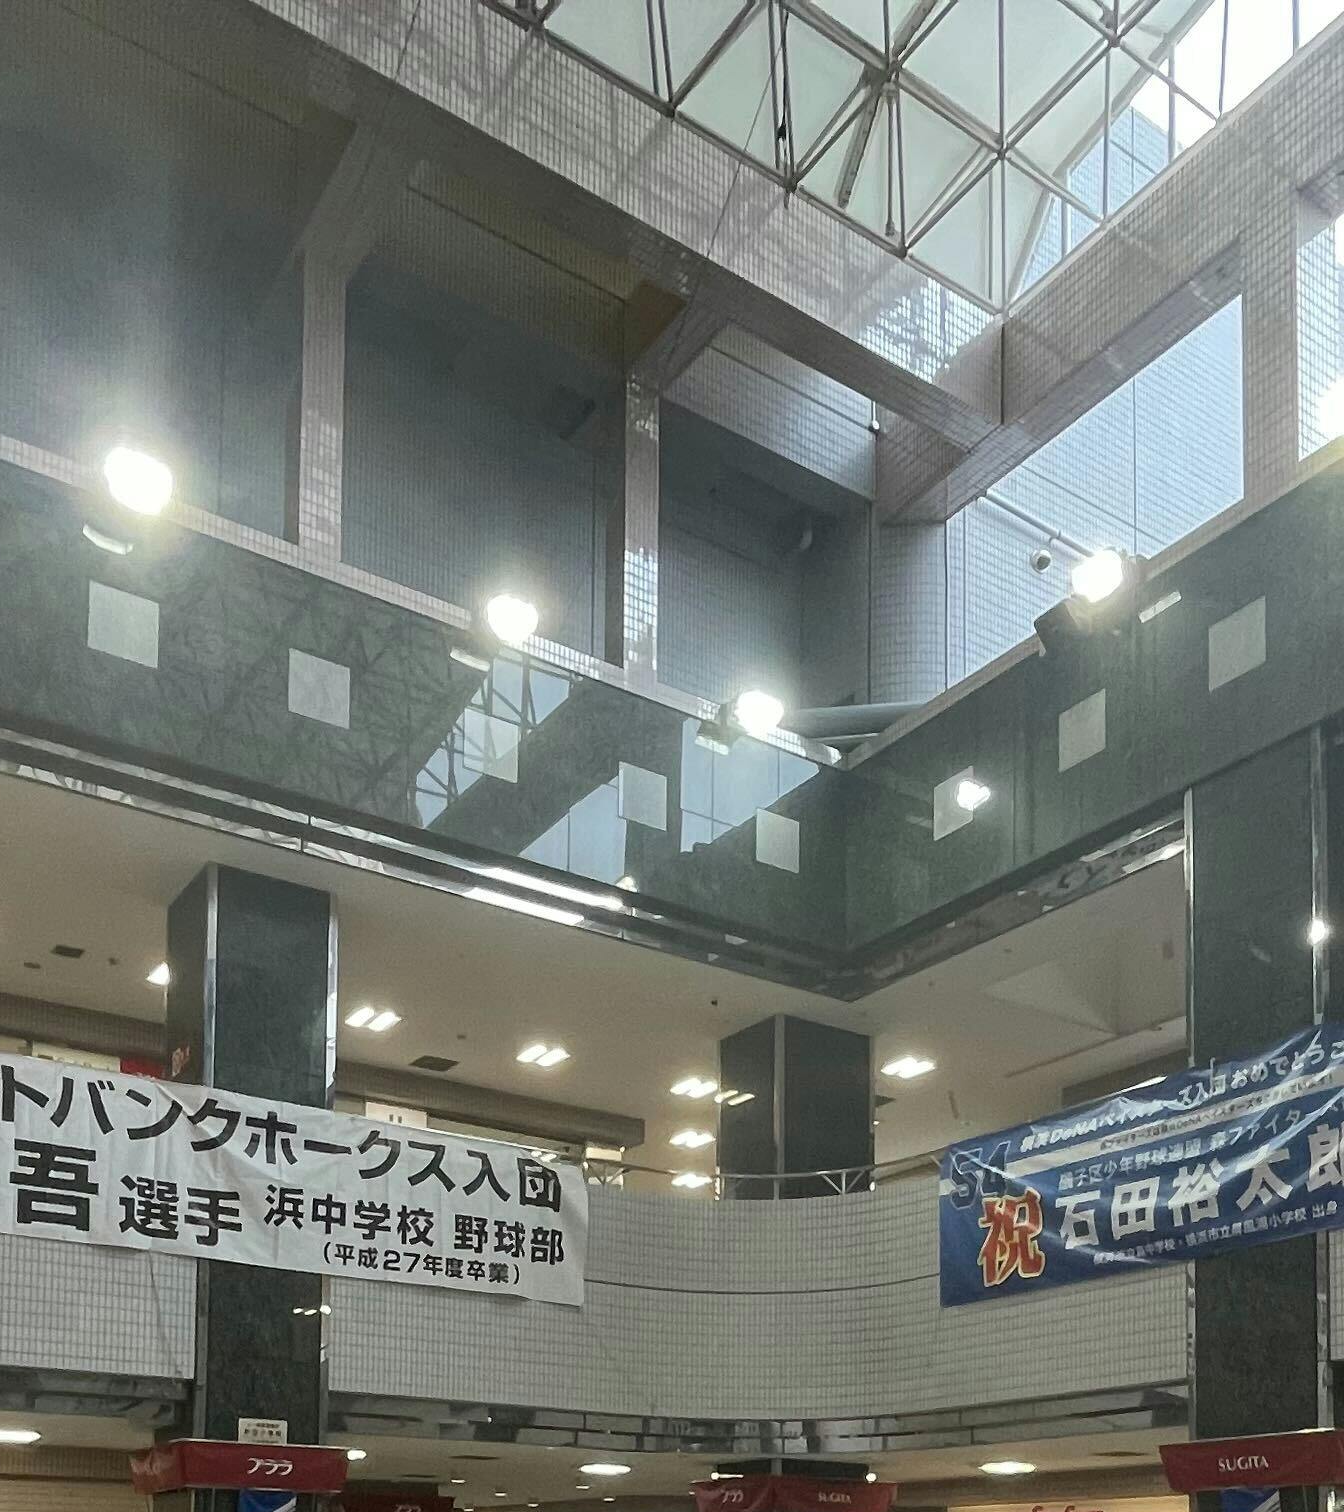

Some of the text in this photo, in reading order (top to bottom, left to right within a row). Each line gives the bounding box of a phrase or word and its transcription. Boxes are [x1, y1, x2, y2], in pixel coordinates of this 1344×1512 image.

[977, 1186, 1045, 1287] 祝
[323, 1241, 521, 1285] (平成27年度卒業)
[1218, 1455, 1269, 1472] SUGITA
